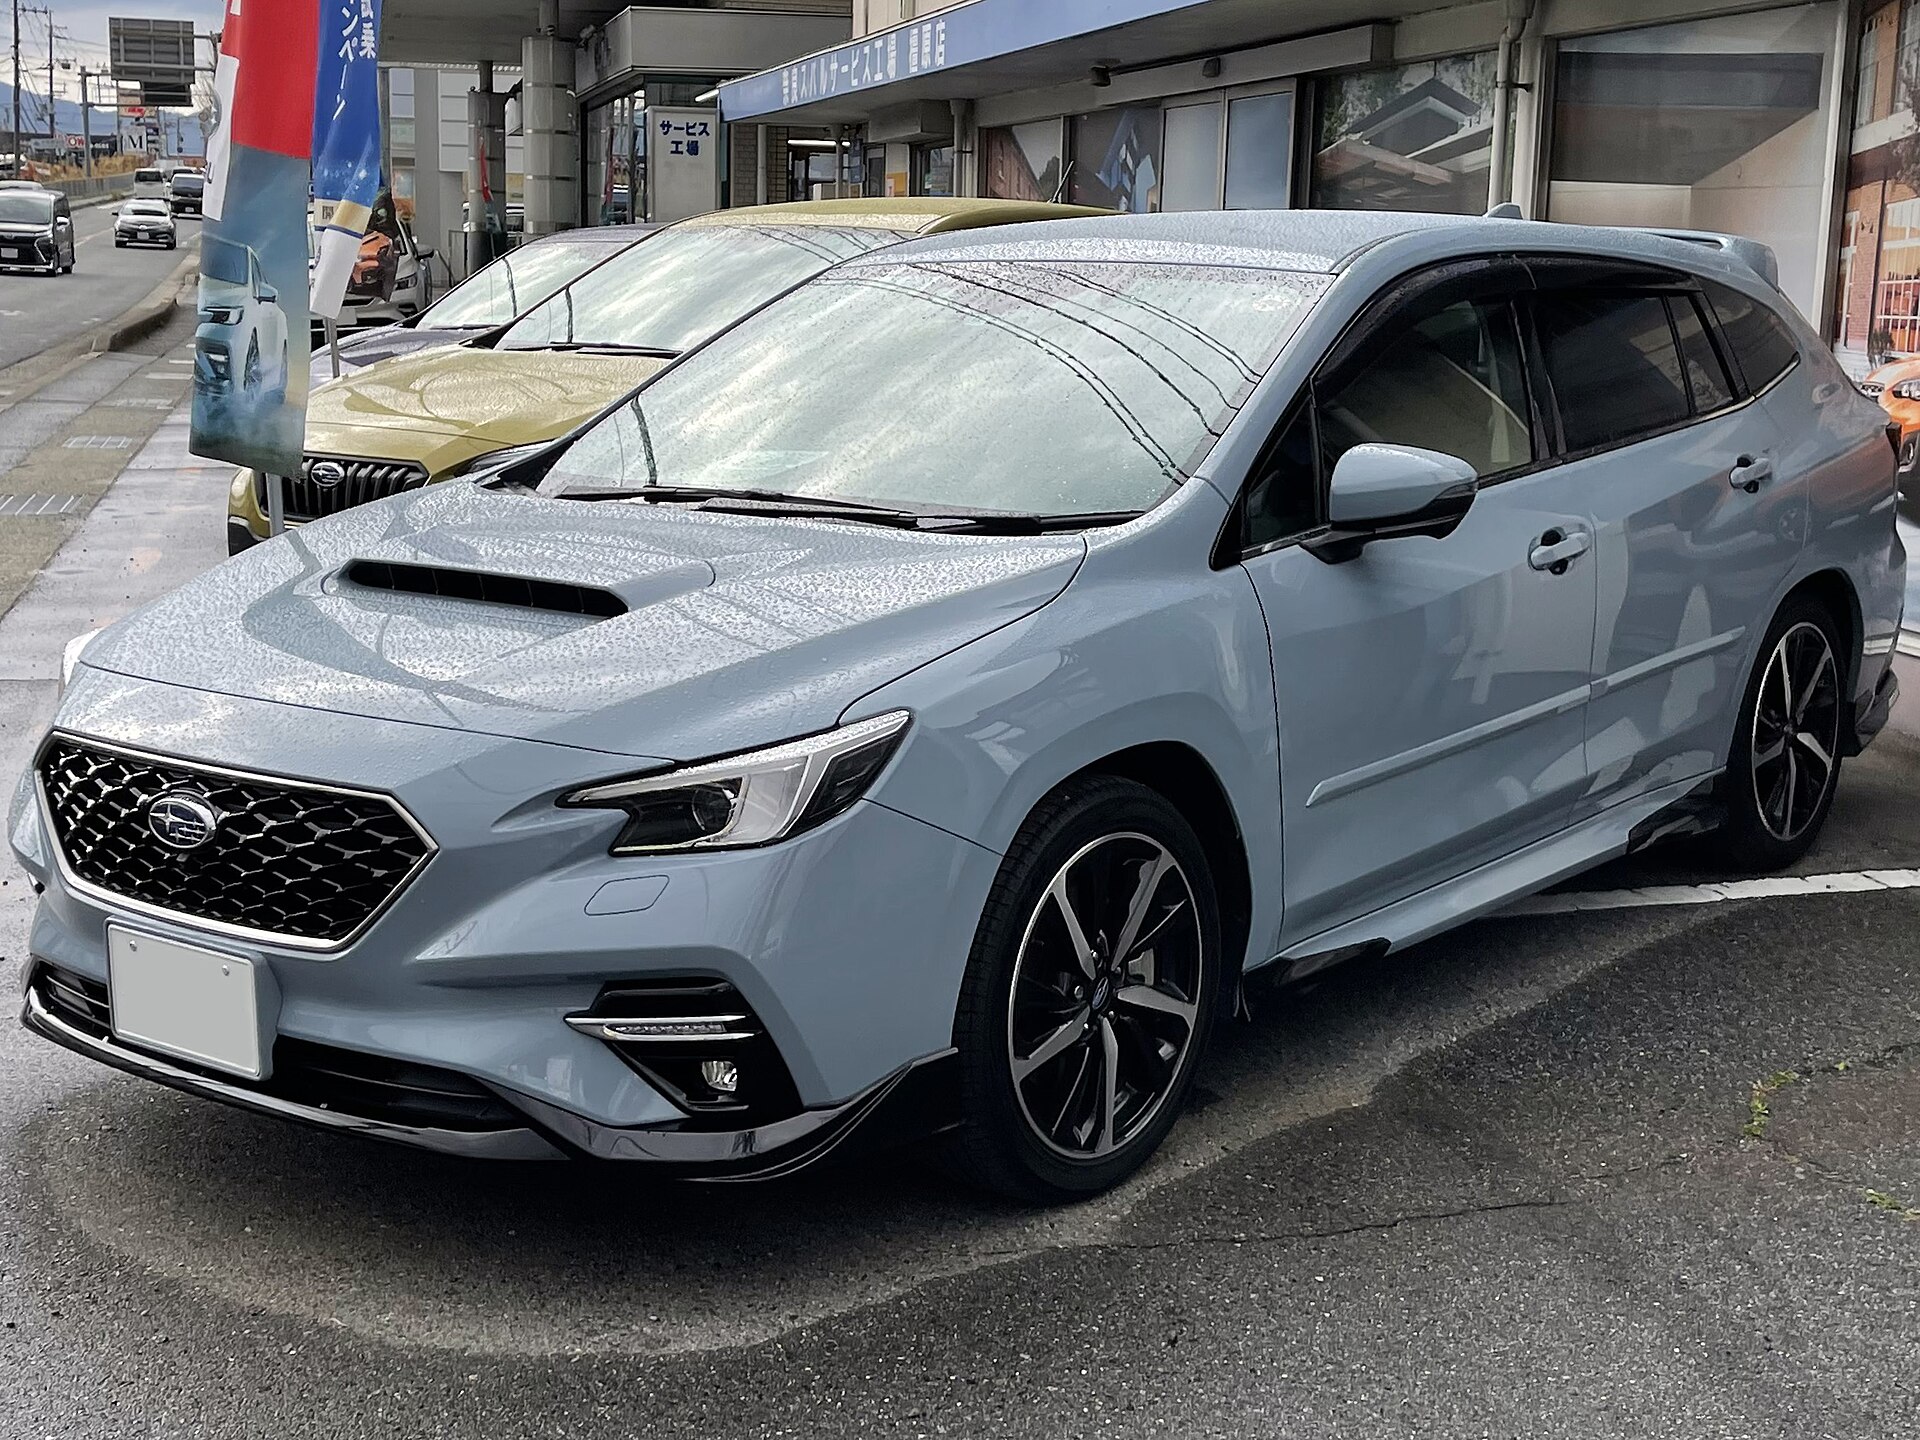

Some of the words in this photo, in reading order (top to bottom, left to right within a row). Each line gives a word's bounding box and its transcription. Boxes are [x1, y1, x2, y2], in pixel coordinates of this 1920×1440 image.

[332, 0, 359, 121] ンペーン
[660, 120, 710, 137] サービス
[670, 140, 699, 156] 工場
